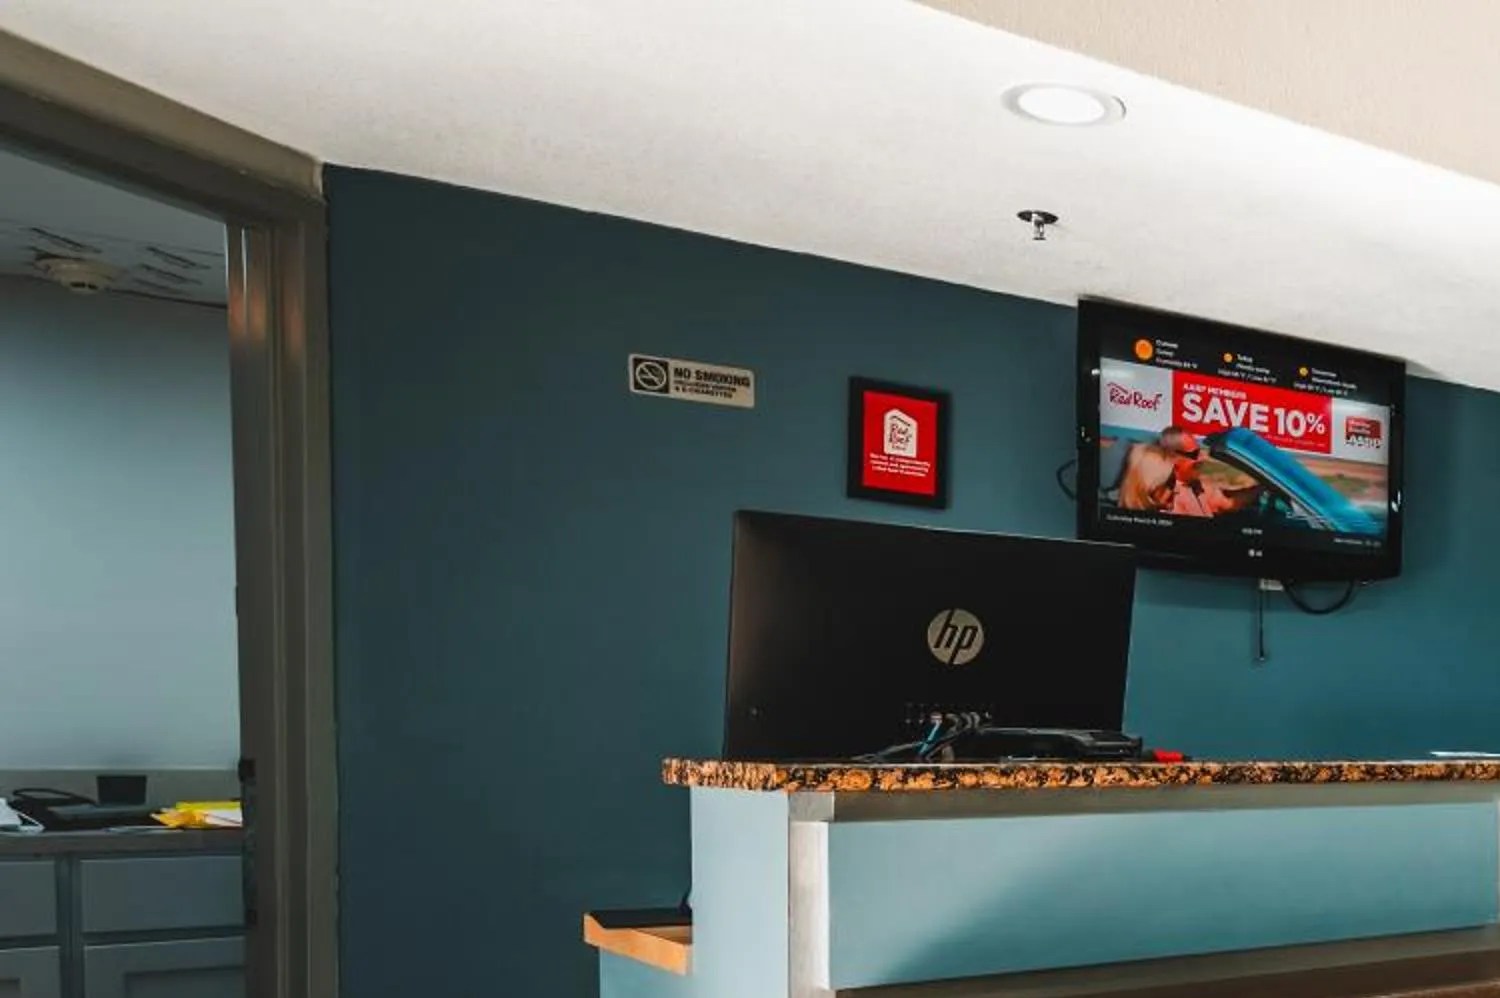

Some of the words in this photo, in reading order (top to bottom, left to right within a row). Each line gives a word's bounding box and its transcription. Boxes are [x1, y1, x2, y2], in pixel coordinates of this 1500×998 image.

[674, 367, 691, 380] NO
[695, 369, 751, 388] SMOKING
[1109, 387, 1133, 405] Red
[1133, 390, 1163, 412] Roof
[1182, 391, 1269, 433] SAVE
[1273, 407, 1326, 438] 10%
[934, 609, 978, 665] hp
